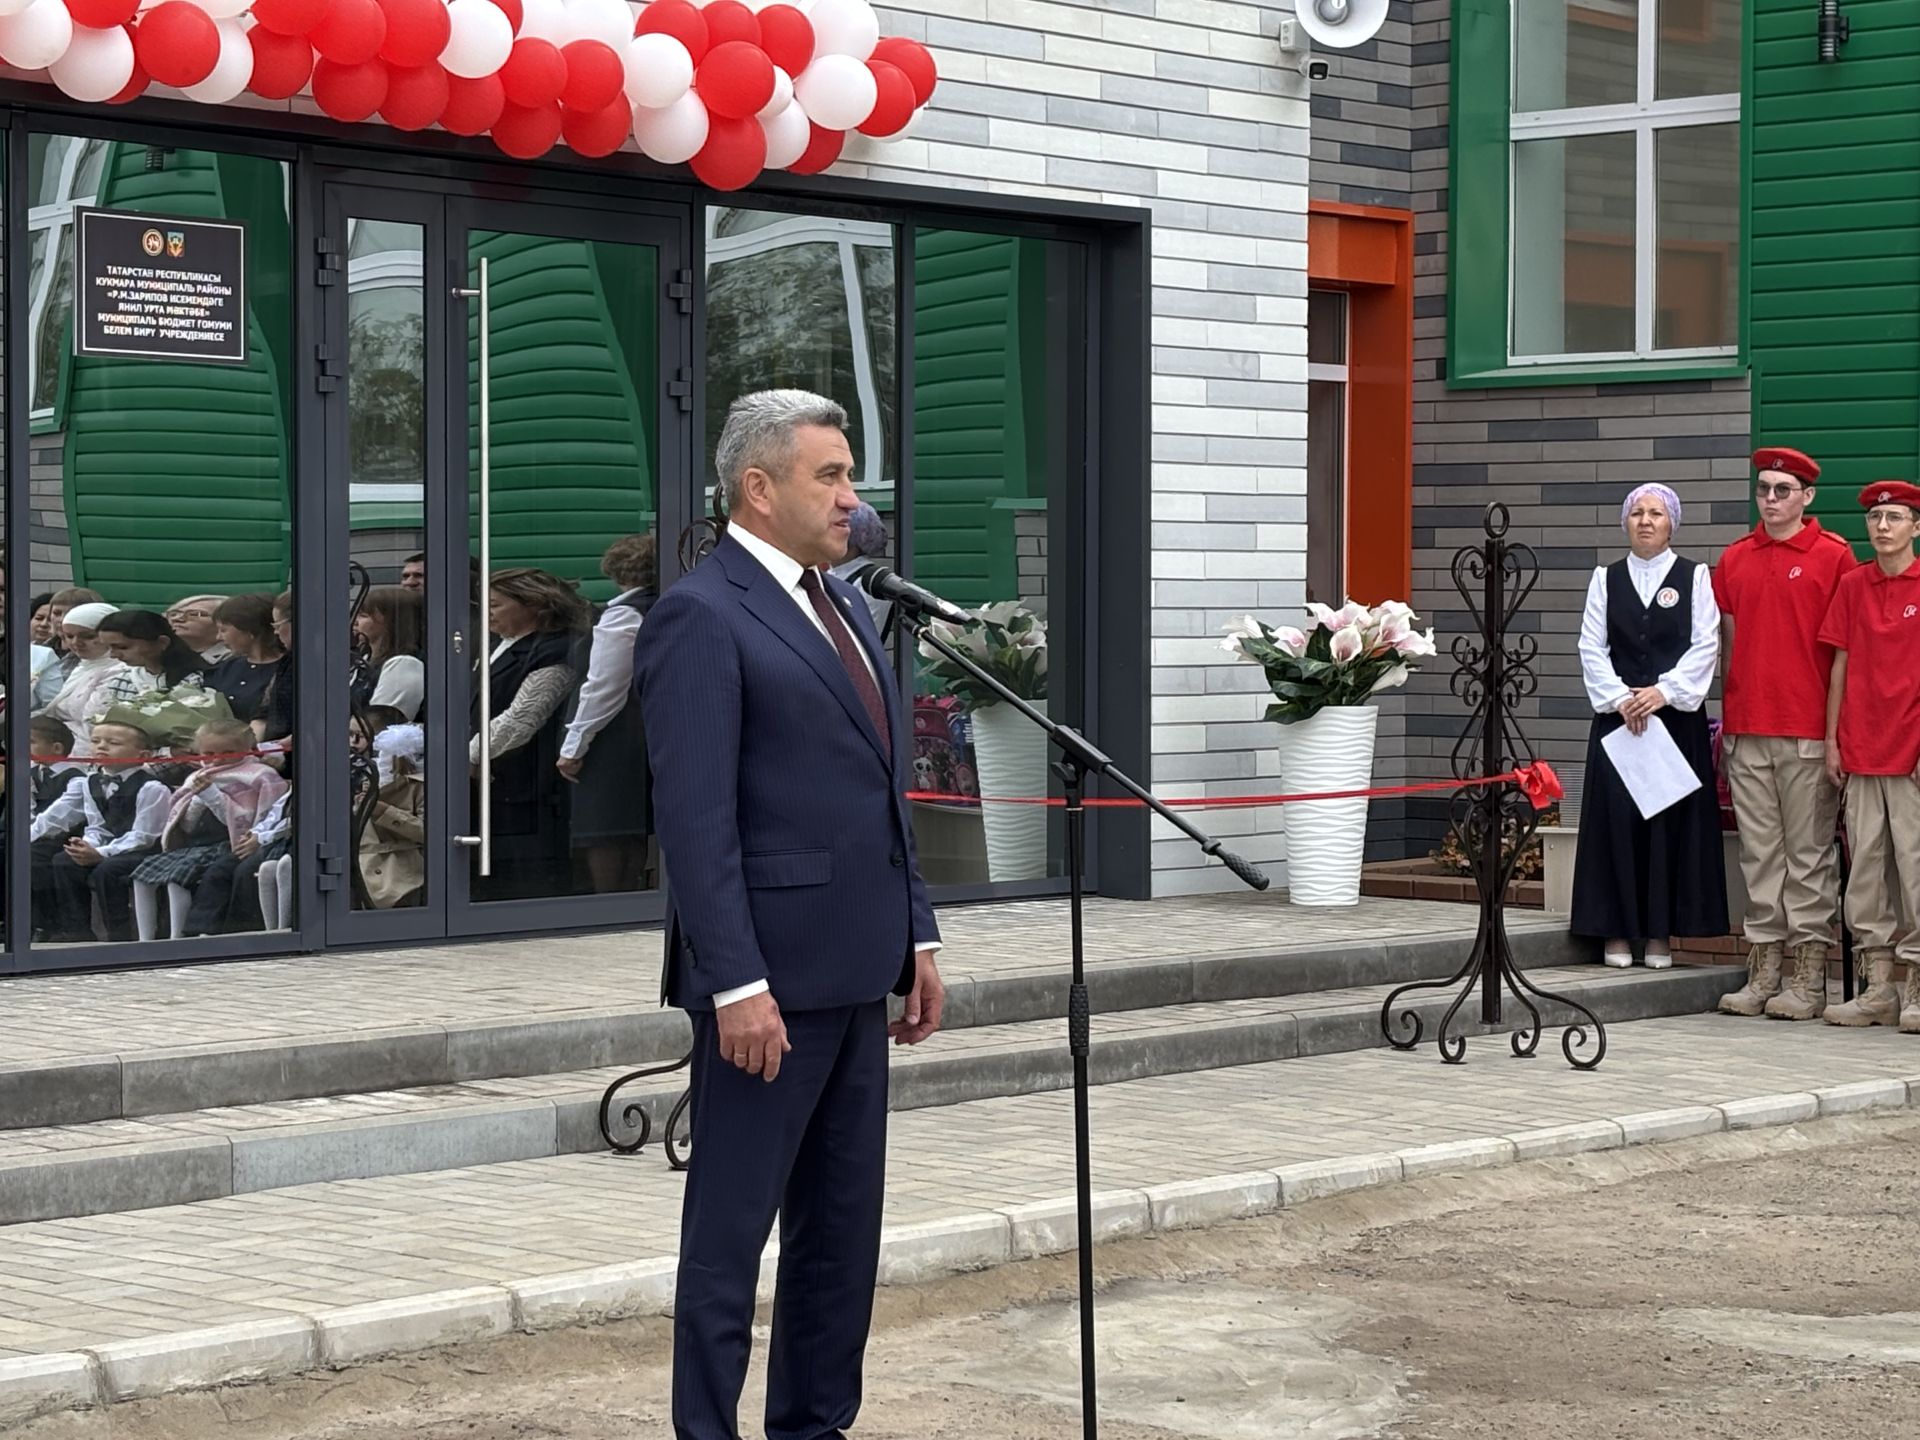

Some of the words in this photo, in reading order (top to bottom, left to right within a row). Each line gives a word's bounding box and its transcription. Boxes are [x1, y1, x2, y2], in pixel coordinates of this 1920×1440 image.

[106, 265, 154, 278] ТАТАРСТАН
[155, 269, 222, 283] РЕСПУБЛИКАСЫ
[95, 277, 136, 288] КУКМАРА
[136, 280, 195, 293] МУНИЦИПАЛЬ
[196, 284, 232, 296] РАЙОНЫ
[143, 304, 165, 315] УРТА
[97, 312, 157, 326] МУНИЦИПАЛЬ
[158, 316, 196, 329] БЮДЖЕТ
[197, 319, 233, 331] ГОМУМИ
[103, 325, 133, 336] БЕЛЕМ
[159, 328, 225, 342] УЧРЕЖДЕНИЕСЕ
